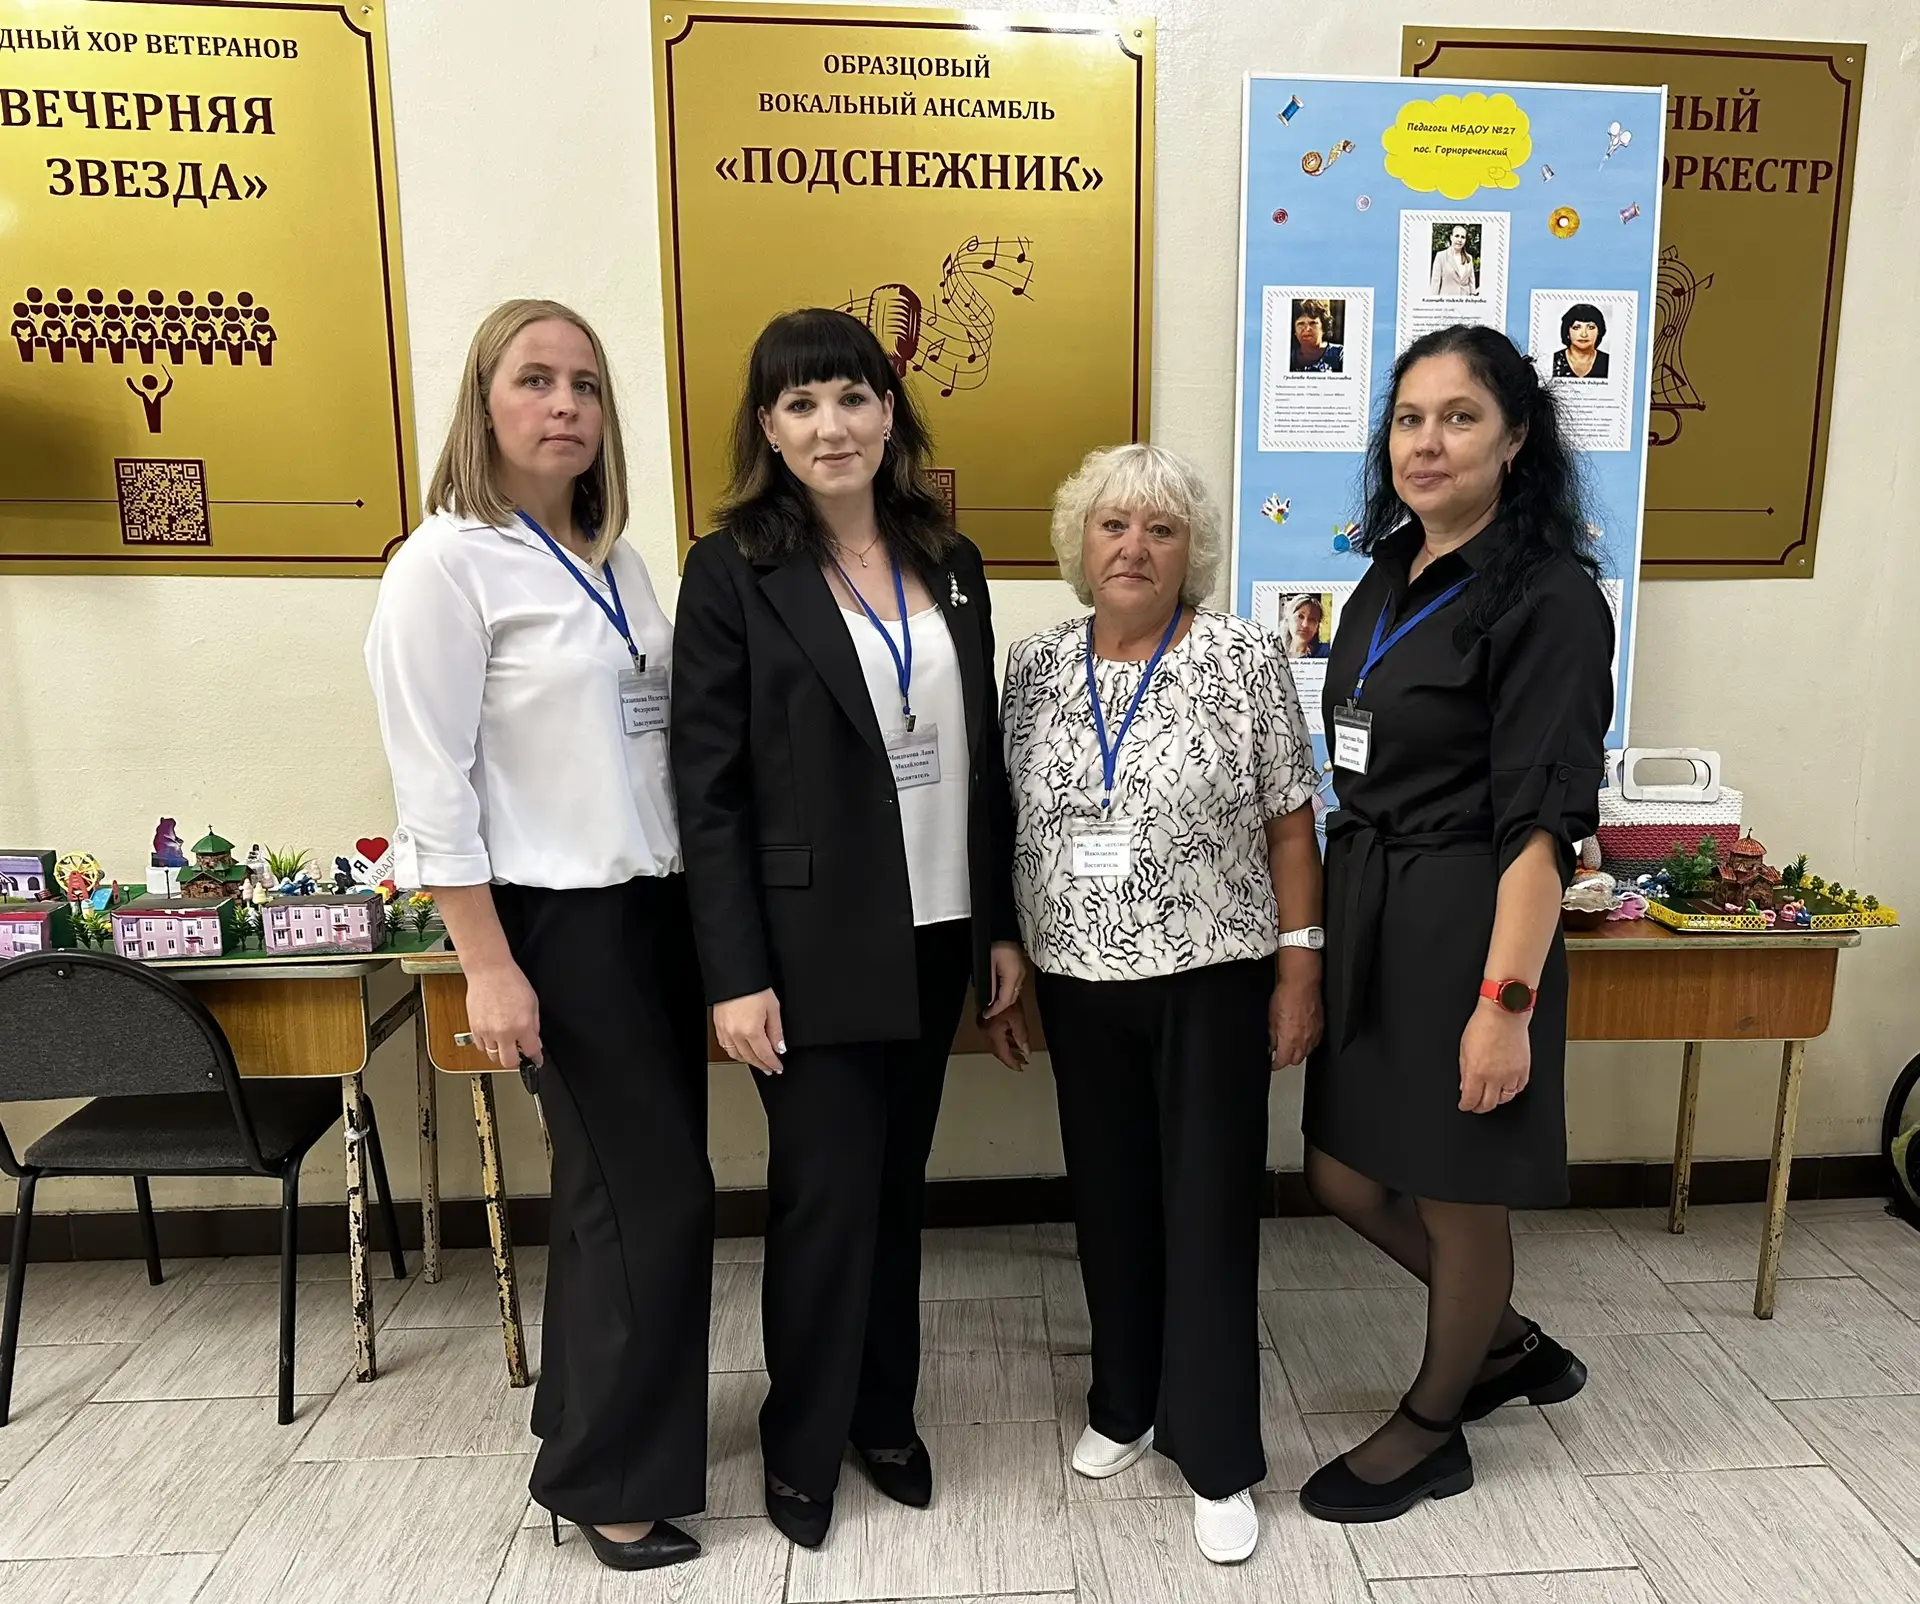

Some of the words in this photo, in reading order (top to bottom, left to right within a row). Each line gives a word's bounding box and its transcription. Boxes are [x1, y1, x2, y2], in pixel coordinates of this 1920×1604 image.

[87, 31, 138, 53] ХОР
[146, 34, 299, 59] ВЕТЕРАНОВ
[823, 53, 991, 79] ОБРАЗЦОВЫЙ
[0, 88, 276, 135] ВЕЧЕРНЯЯ
[758, 91, 917, 117] ВОКАЛЬНЫЙ
[923, 97, 1056, 121] АНСАМБЛЬ
[1407, 122, 1448, 133] Педагоги
[1451, 124, 1490, 135] МБДОУ
[1492, 126, 1516, 135] №27
[1413, 146, 1431, 154] пос.
[1435, 145, 1508, 157] Горнореченский
[46, 158, 268, 208] ЗВЕЗДА»
[715, 146, 1104, 194] «ПОДСНЕЖНИК»
[1663, 155, 1833, 194] РКЕСТР
[353, 859, 369, 874] Я
[366, 851, 395, 888] КАВАЛ
